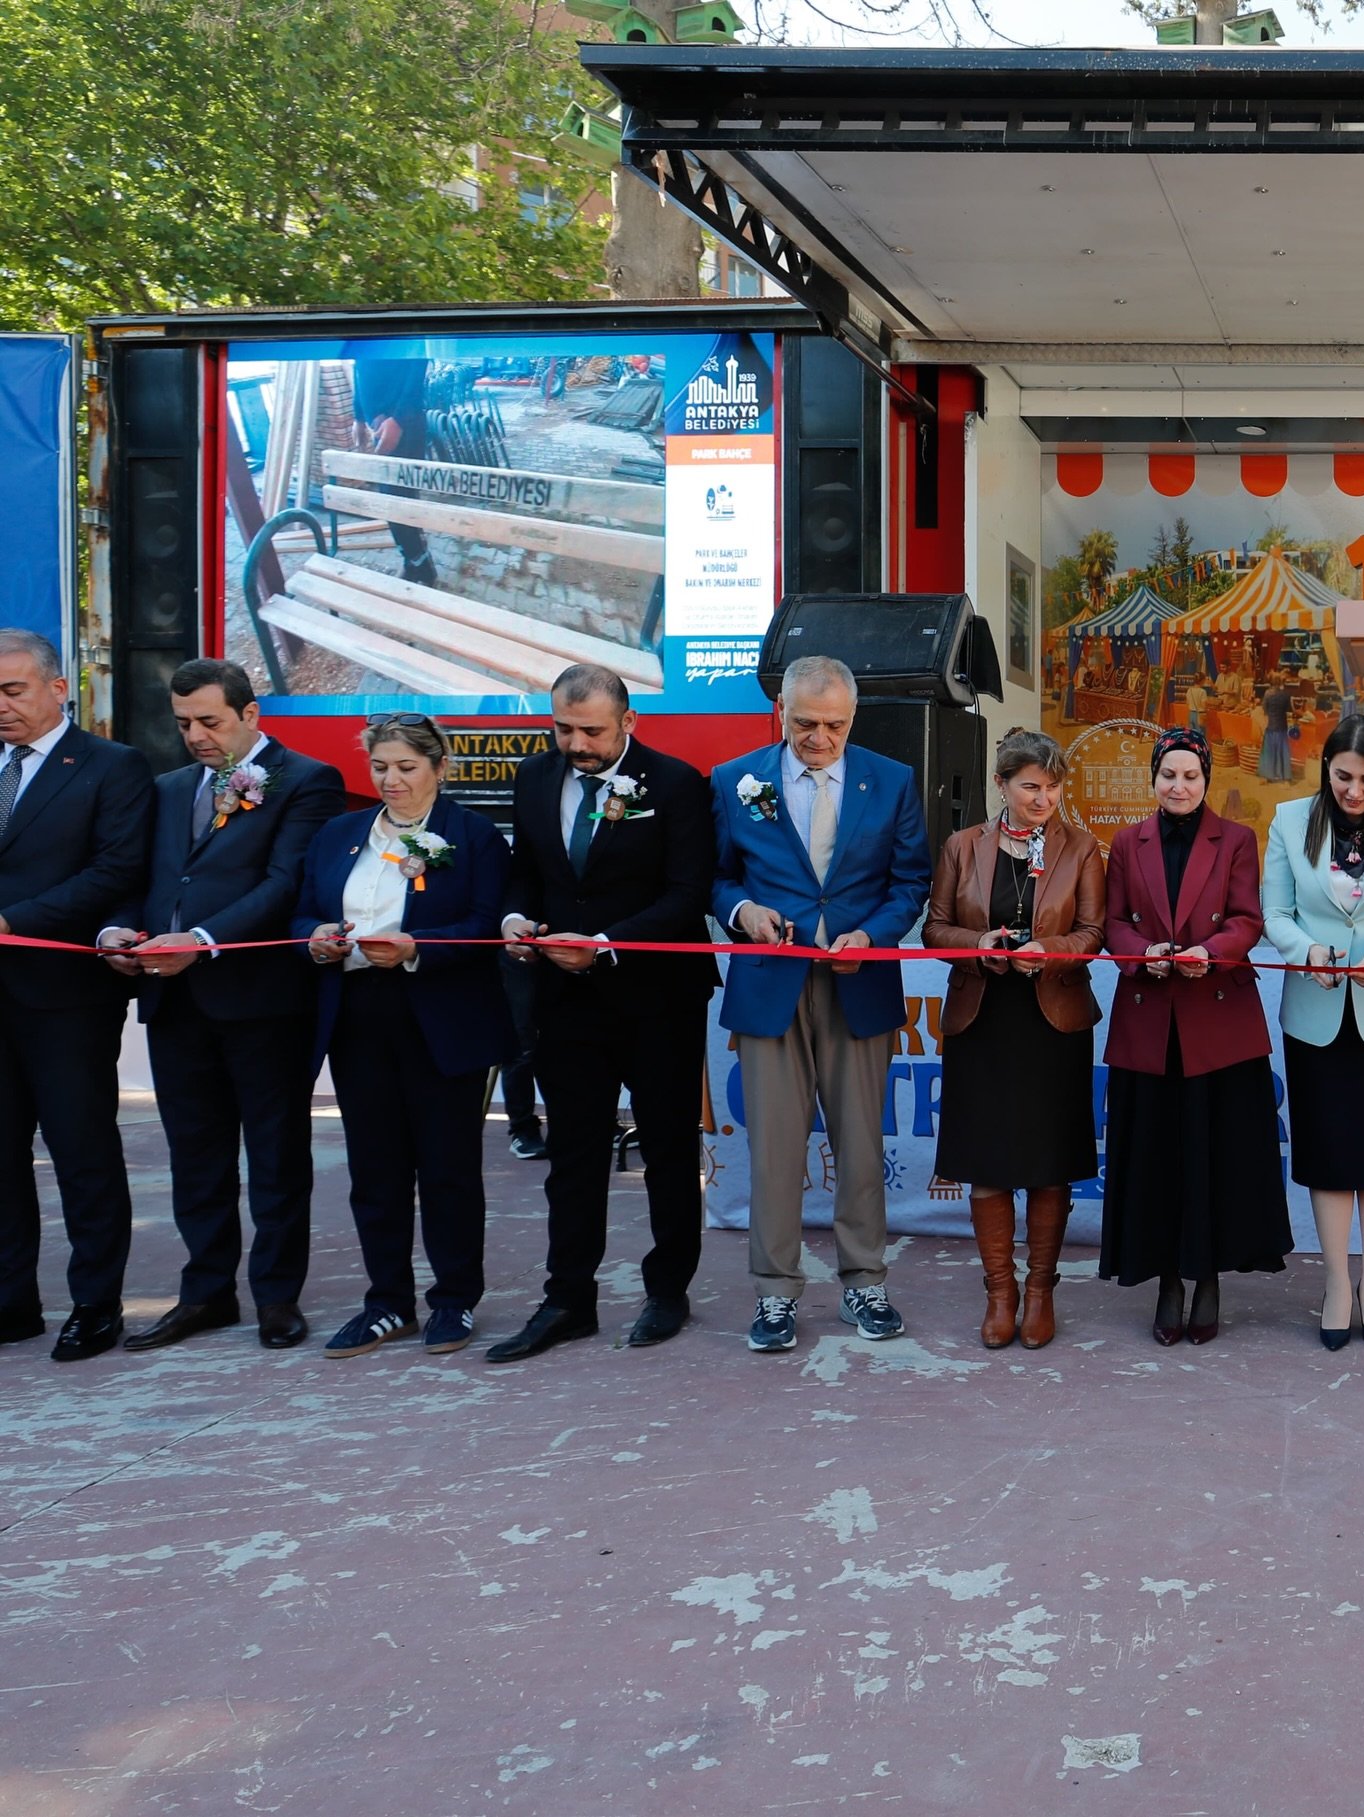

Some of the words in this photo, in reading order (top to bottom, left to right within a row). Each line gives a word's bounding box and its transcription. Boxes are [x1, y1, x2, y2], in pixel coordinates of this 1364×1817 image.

[738, 373, 757, 382] 1939
[685, 405, 759, 418] ANTAKYA
[684, 419, 760, 430] BELEDİYESİ
[691, 448, 718, 460] PARK
[719, 448, 752, 461] BAHÇE
[397, 464, 456, 493] ANTAKYA
[447, 735, 549, 754] NTAKYA
[1089, 815, 1122, 824] HATAY
